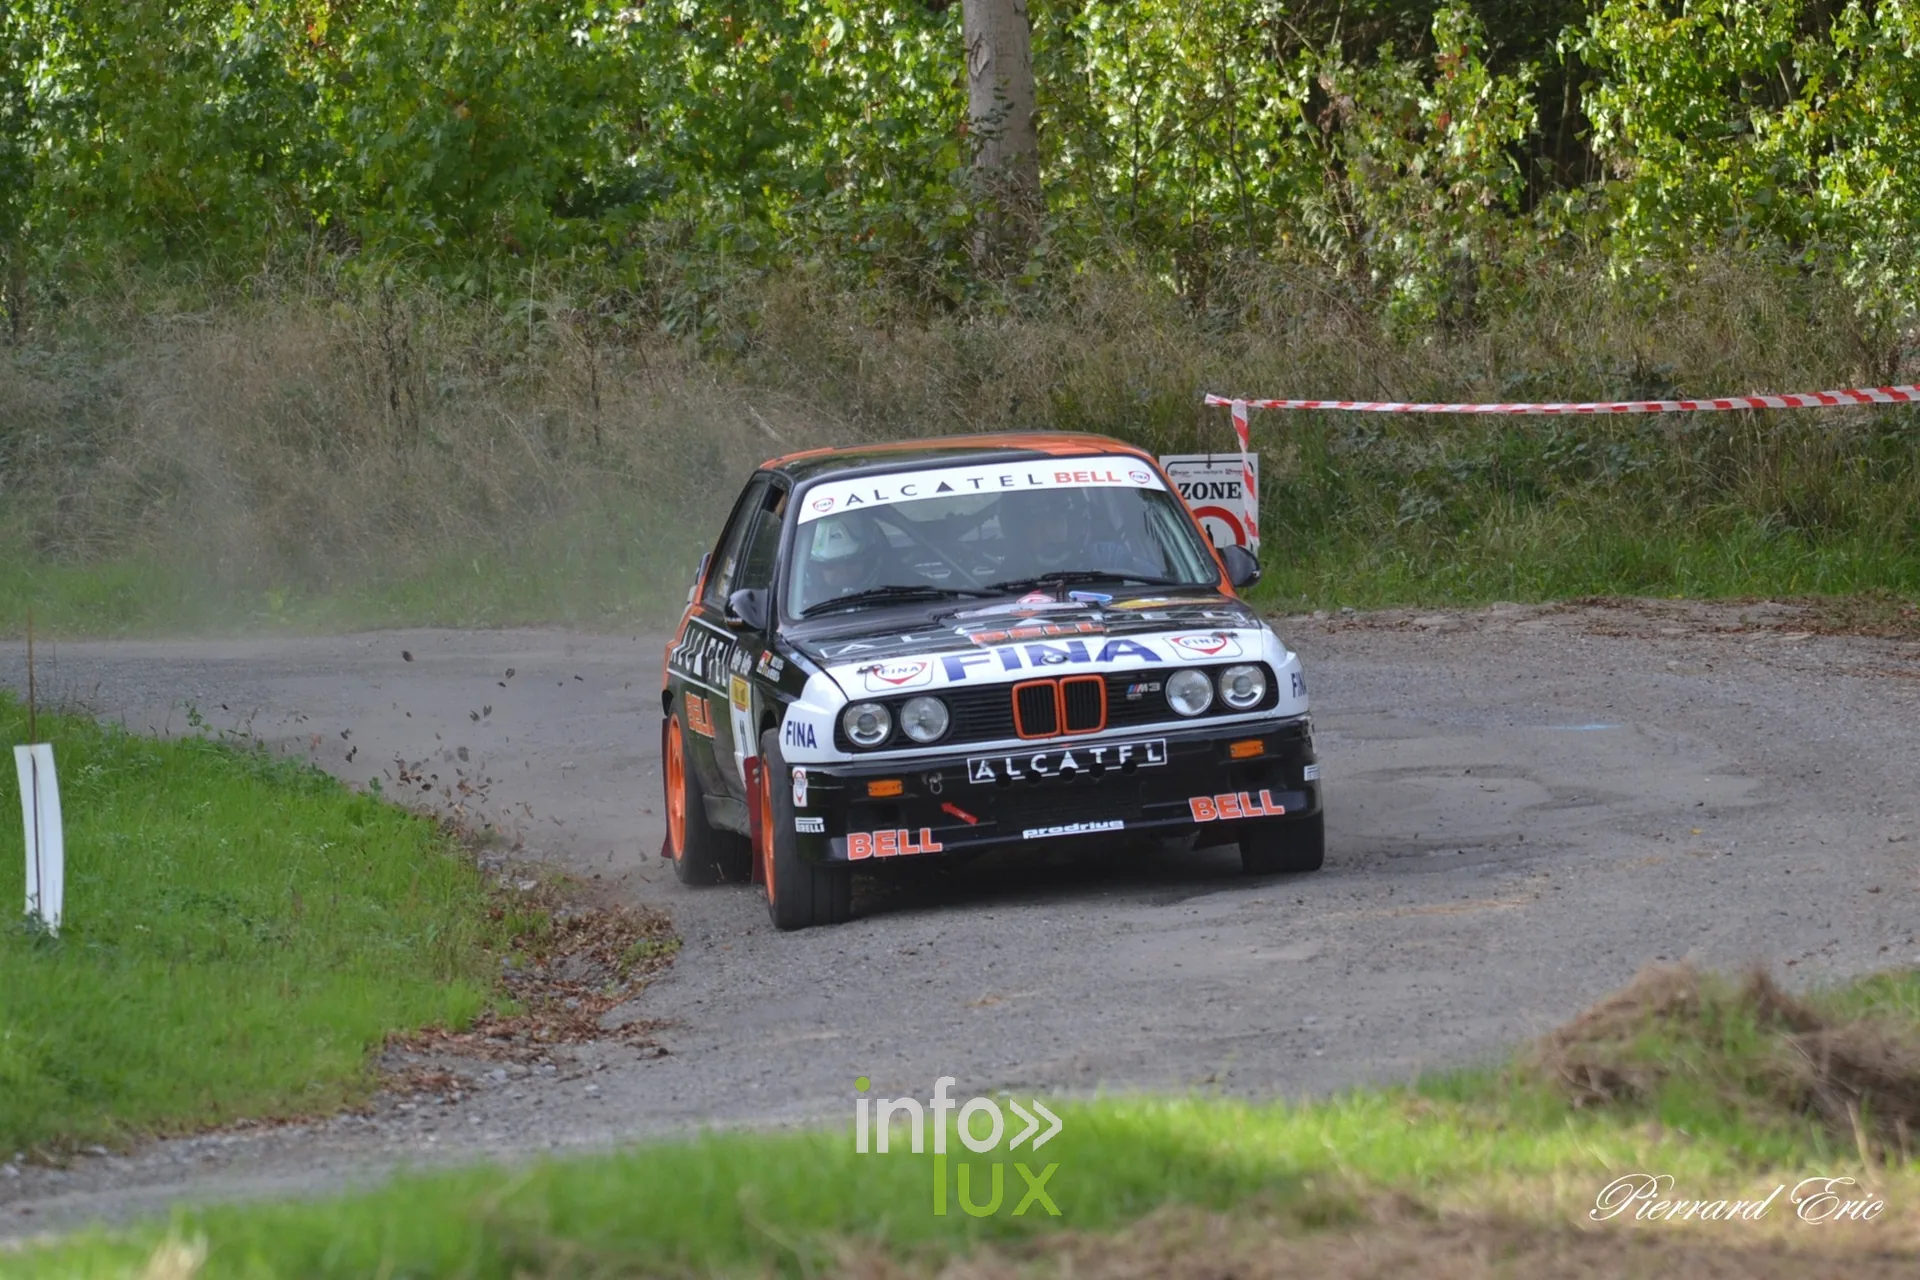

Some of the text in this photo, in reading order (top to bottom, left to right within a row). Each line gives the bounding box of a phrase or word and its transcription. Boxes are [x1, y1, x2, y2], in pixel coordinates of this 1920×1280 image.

[845, 471, 1122, 507] ALCATEL BELL
[1178, 481, 1242, 500] ZONE
[1183, 634, 1224, 647] FINA
[881, 664, 921, 676] FINA
[940, 638, 1163, 682] FINA
[1135, 682, 1161, 693] M3
[786, 720, 818, 749] FINA
[1189, 789, 1286, 822] BELL
[1022, 820, 1125, 839] prodrive
[847, 827, 943, 861] BELL
